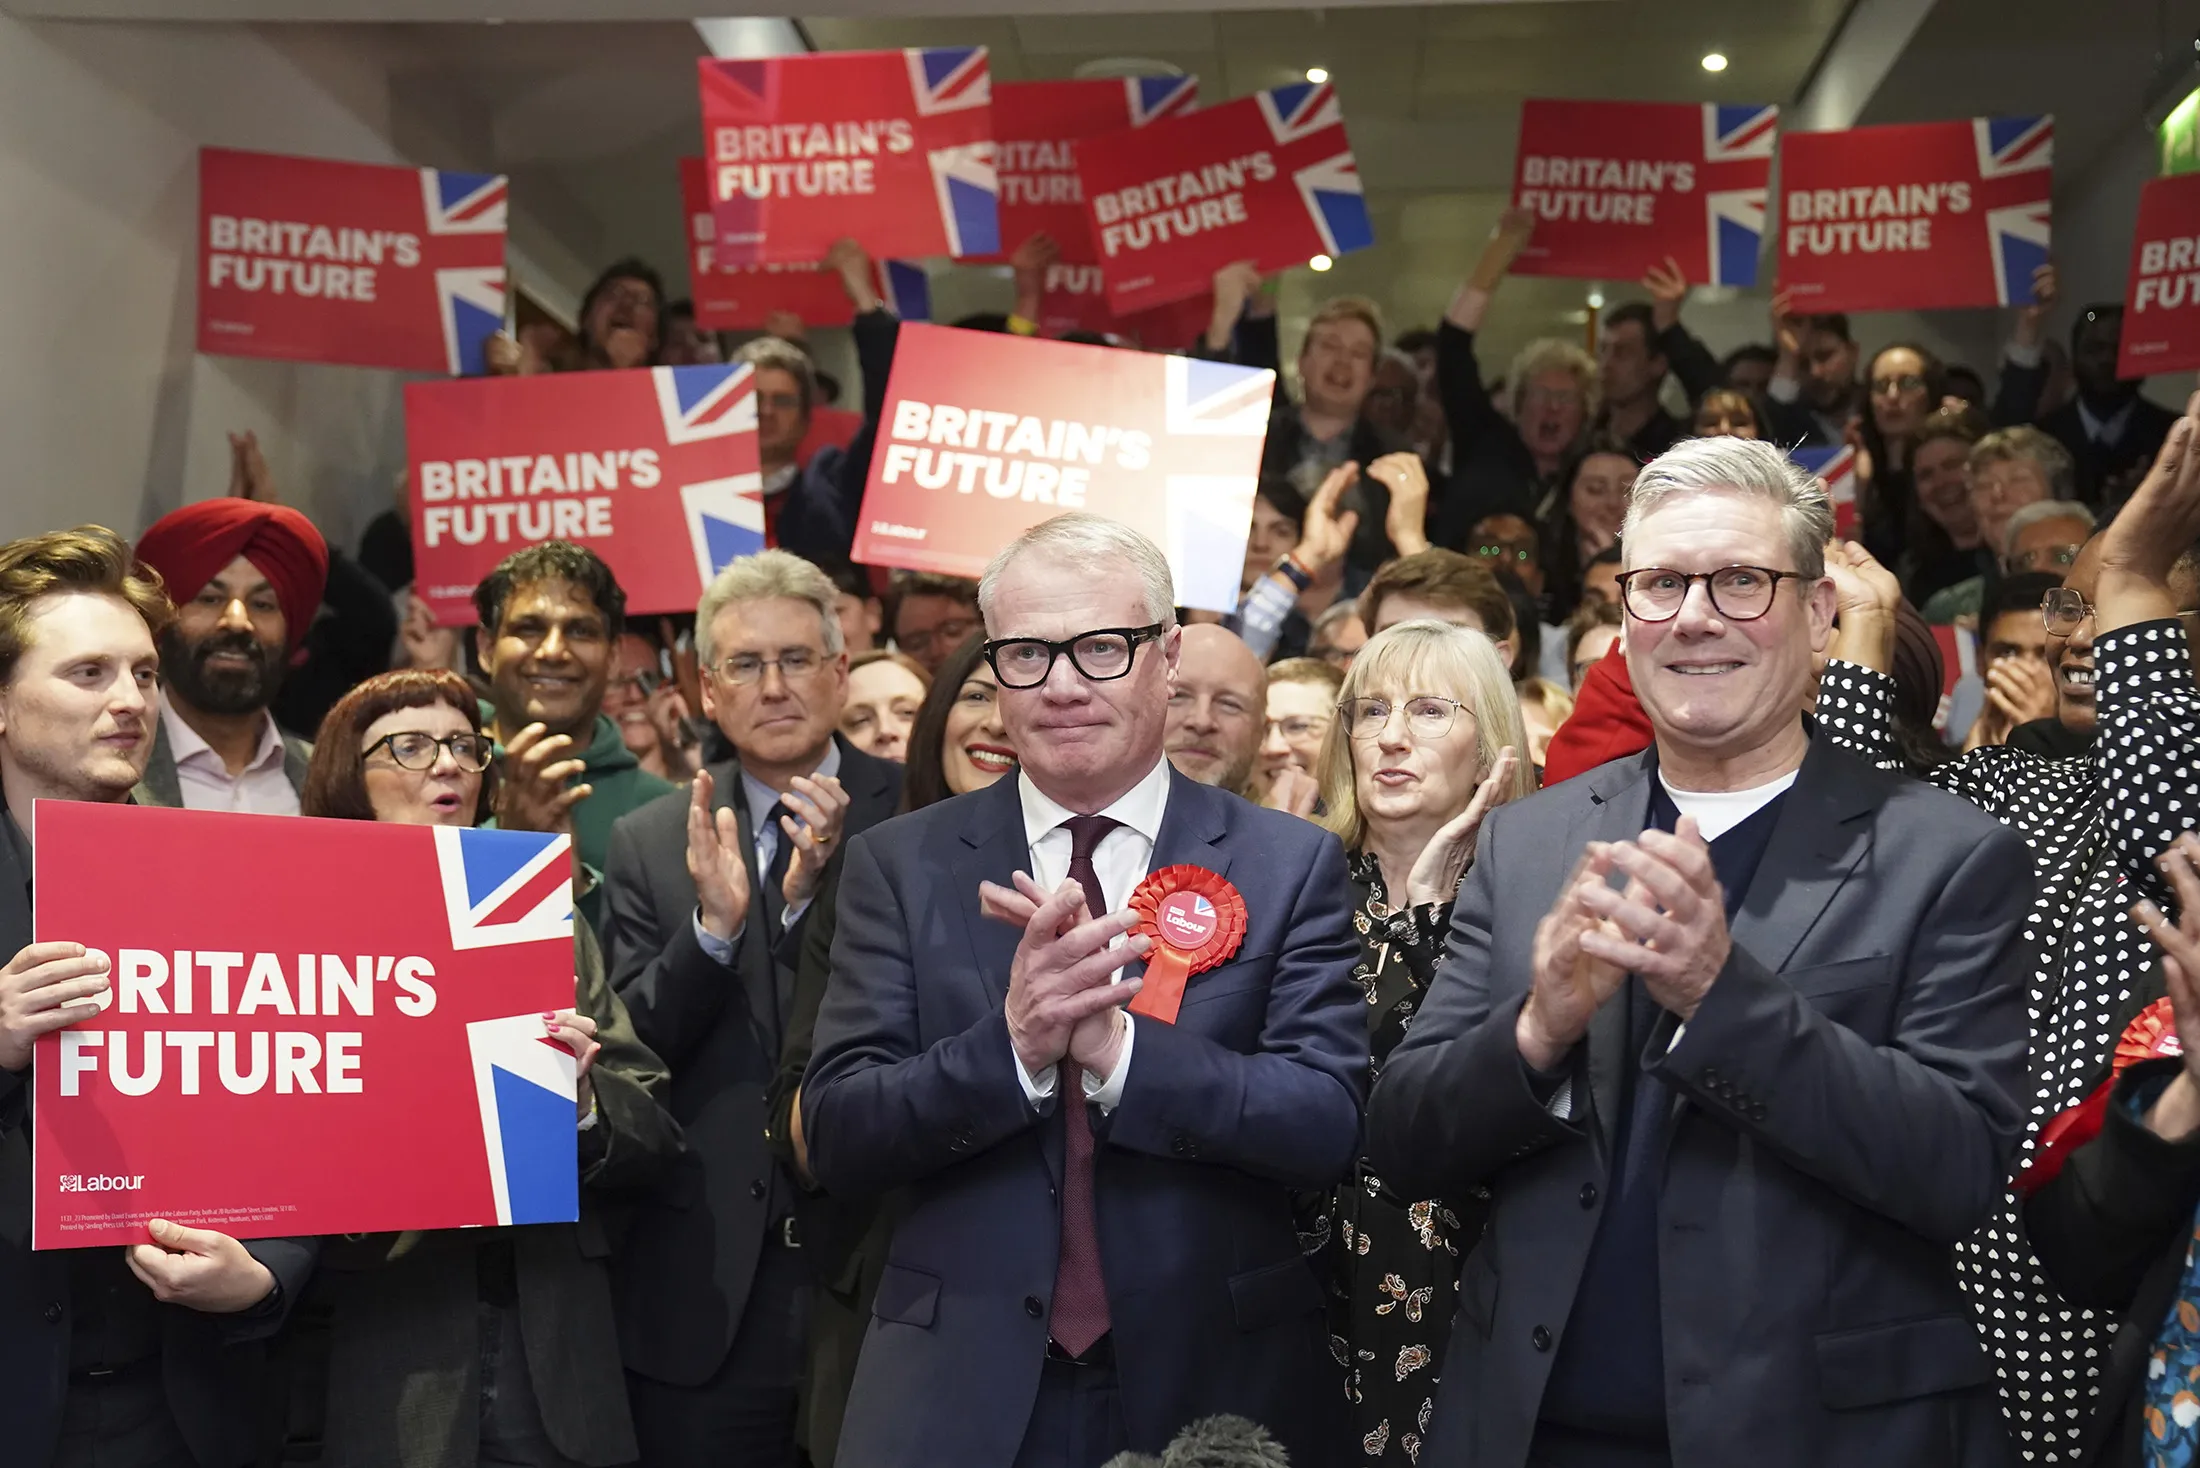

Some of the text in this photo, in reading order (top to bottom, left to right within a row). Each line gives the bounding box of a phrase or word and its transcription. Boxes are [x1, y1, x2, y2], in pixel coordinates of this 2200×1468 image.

[716, 118, 914, 163] BRITAIN'S
[718, 159, 875, 200] FUTURE
[1094, 152, 1277, 224] BRITAIN'S
[1523, 156, 1695, 193] BRITAIN'S
[1101, 192, 1246, 257] FUTURE
[1519, 190, 1655, 224] FUTURE
[1788, 182, 1971, 221] BRITAIN'S
[209, 216, 421, 268] BRITAIN'S
[1787, 219, 1931, 255] FUTURE
[208, 254, 376, 301] FUTURE
[1045, 264, 1104, 295] FUT
[892, 401, 1152, 470] BRITAIN'S
[420, 449, 661, 501] BRITAIN'S
[882, 445, 1090, 508] FUTURE
[424, 498, 613, 546] FUTURE
[1166, 913, 1207, 934] Labour
[60, 1030, 363, 1097] FUTURE
[77, 1174, 145, 1192] Labour
